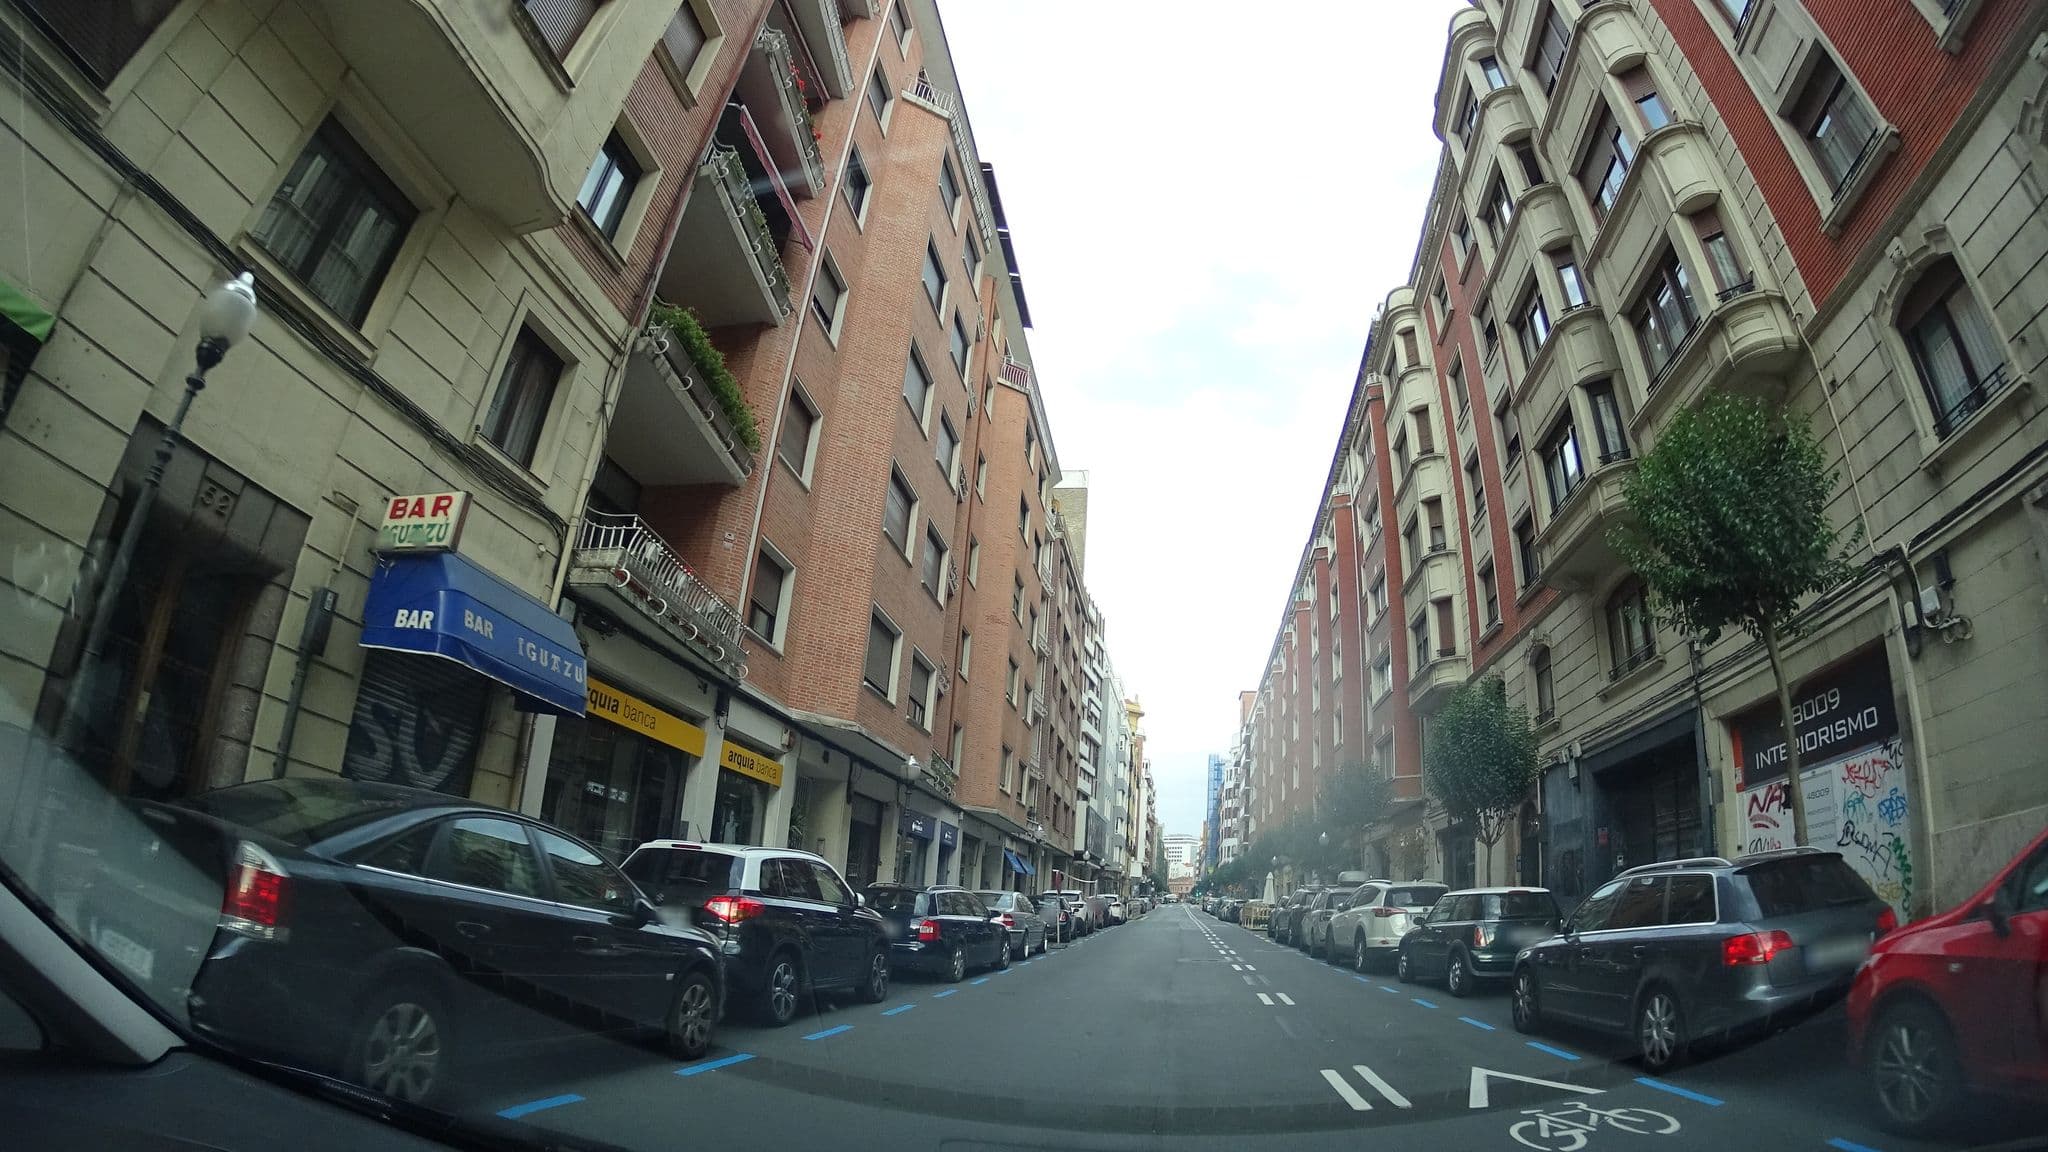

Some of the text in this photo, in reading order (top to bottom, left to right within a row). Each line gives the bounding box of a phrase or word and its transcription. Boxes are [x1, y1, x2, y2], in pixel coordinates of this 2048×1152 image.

[389, 495, 453, 519] BAR
[394, 609, 434, 630] BAR
[464, 609, 494, 640] BAR
[588, 687, 657, 730] quia banca
[1780, 687, 1841, 728] 8009
[728, 750, 777, 780] arquia banca
